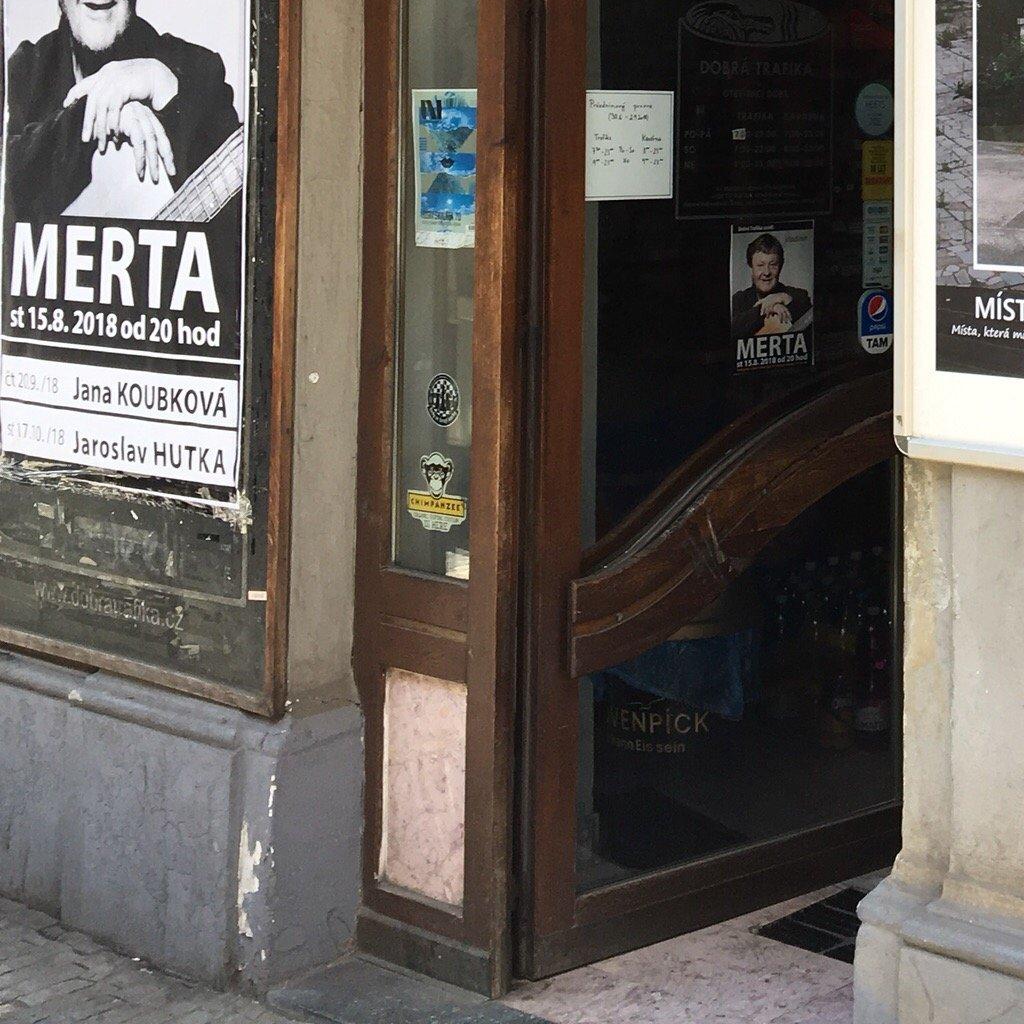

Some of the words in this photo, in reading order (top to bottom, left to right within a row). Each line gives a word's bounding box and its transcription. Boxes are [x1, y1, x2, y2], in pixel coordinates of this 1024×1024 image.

[10, 221, 221, 314] MERTA
[10, 306, 25, 329] st
[27, 306, 69, 333] 15.8.
[71, 309, 117, 338] 2018
[120, 314, 146, 341] od
[149, 317, 173, 344] 20
[177, 317, 221, 347] hod
[866, 337, 888, 348] TAM
[951, 324, 981, 339] Místa,
[983, 325, 1010, 339] která
[736, 333, 808, 361] MERTA
[73, 376, 112, 404] Jana
[117, 381, 228, 418] KOUBKOVÁ
[72, 430, 147, 465] Jaroslav
[153, 441, 226, 475] HUTKA
[410, 498, 461, 512] CHIMPANZEE
